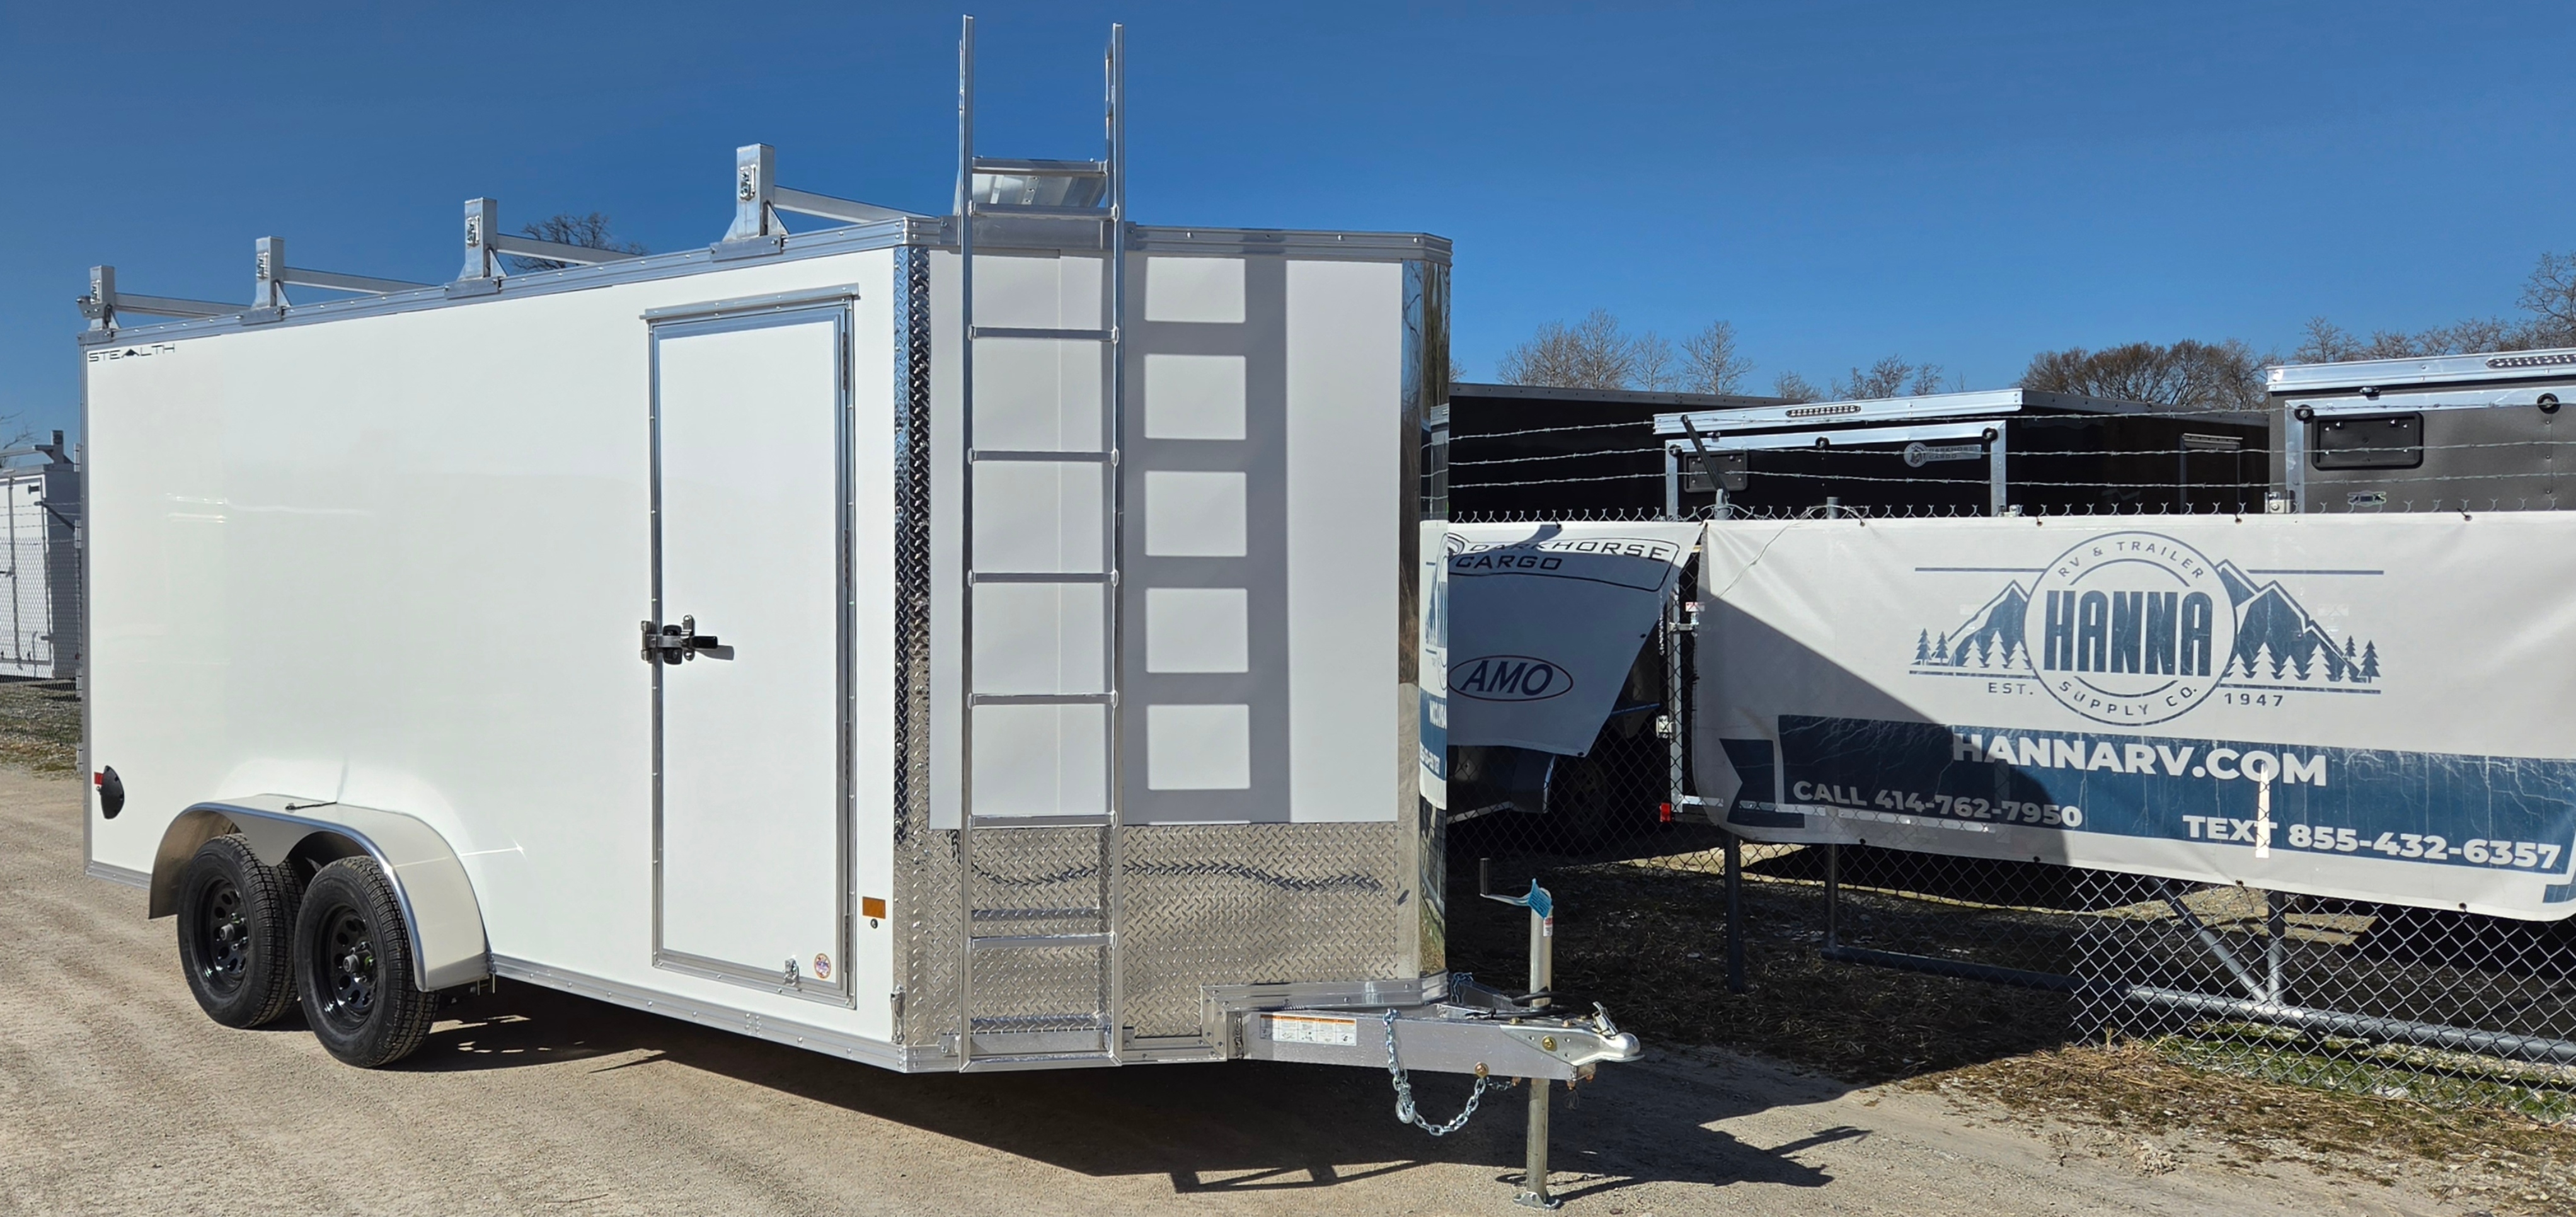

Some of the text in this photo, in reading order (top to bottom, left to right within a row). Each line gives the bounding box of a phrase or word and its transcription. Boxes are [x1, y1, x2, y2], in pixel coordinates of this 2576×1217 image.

[88, 343, 175, 362] STEALTH
[1456, 556, 1563, 570] CARGO
[1469, 541, 1669, 562] DARKHORSE
[2058, 541, 2204, 578] RV & TRAILER
[2044, 590, 2212, 677] HANNA
[1459, 660, 1554, 695] AMO
[1988, 682, 2033, 695] EST.
[2059, 681, 2198, 716] SUPPLY CO.
[2224, 693, 2284, 707] 1947
[1954, 733, 2326, 787] HANNARV.COM
[1793, 780, 2083, 828] CALL 414-762-7950
[2288, 824, 2562, 869] 855-432-6357
